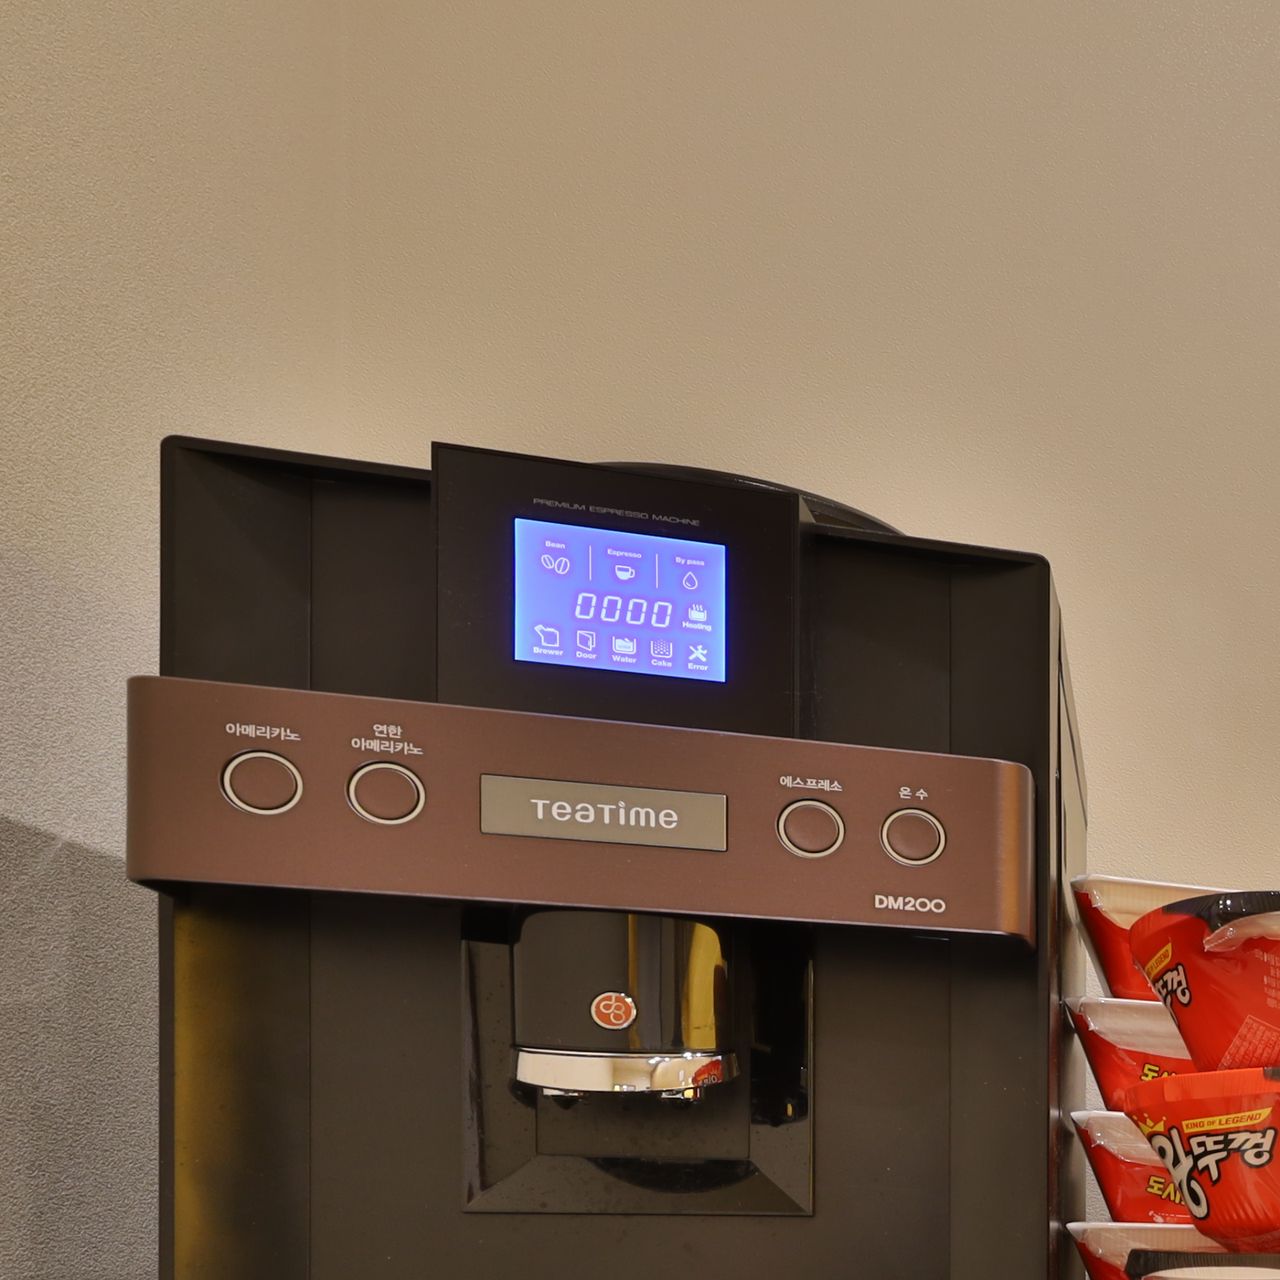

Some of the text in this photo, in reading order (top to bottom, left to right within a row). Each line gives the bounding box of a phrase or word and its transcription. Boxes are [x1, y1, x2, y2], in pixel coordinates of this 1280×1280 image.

[532, 497, 701, 527] PREMIUM ESPRESSO MACHINE
[545, 540, 566, 550] Bean
[607, 548, 642, 559] Espresso
[574, 592, 673, 628] 0000
[682, 620, 713, 632] Heating
[533, 646, 564, 657] Brewer
[576, 651, 597, 661] Door
[612, 655, 637, 664] Water
[651, 658, 673, 668] Cake
[688, 662, 709, 672] Error
[225, 722, 301, 741] 아메리카노
[373, 723, 403, 740] 연한
[351, 737, 424, 756] 아메리카노
[778, 775, 845, 793] 에스프레소
[873, 893, 947, 914] DM200
[1186, 1112, 1262, 1130] KING OF LEGEND
[1150, 1125, 1278, 1221] 왕뚜껑
